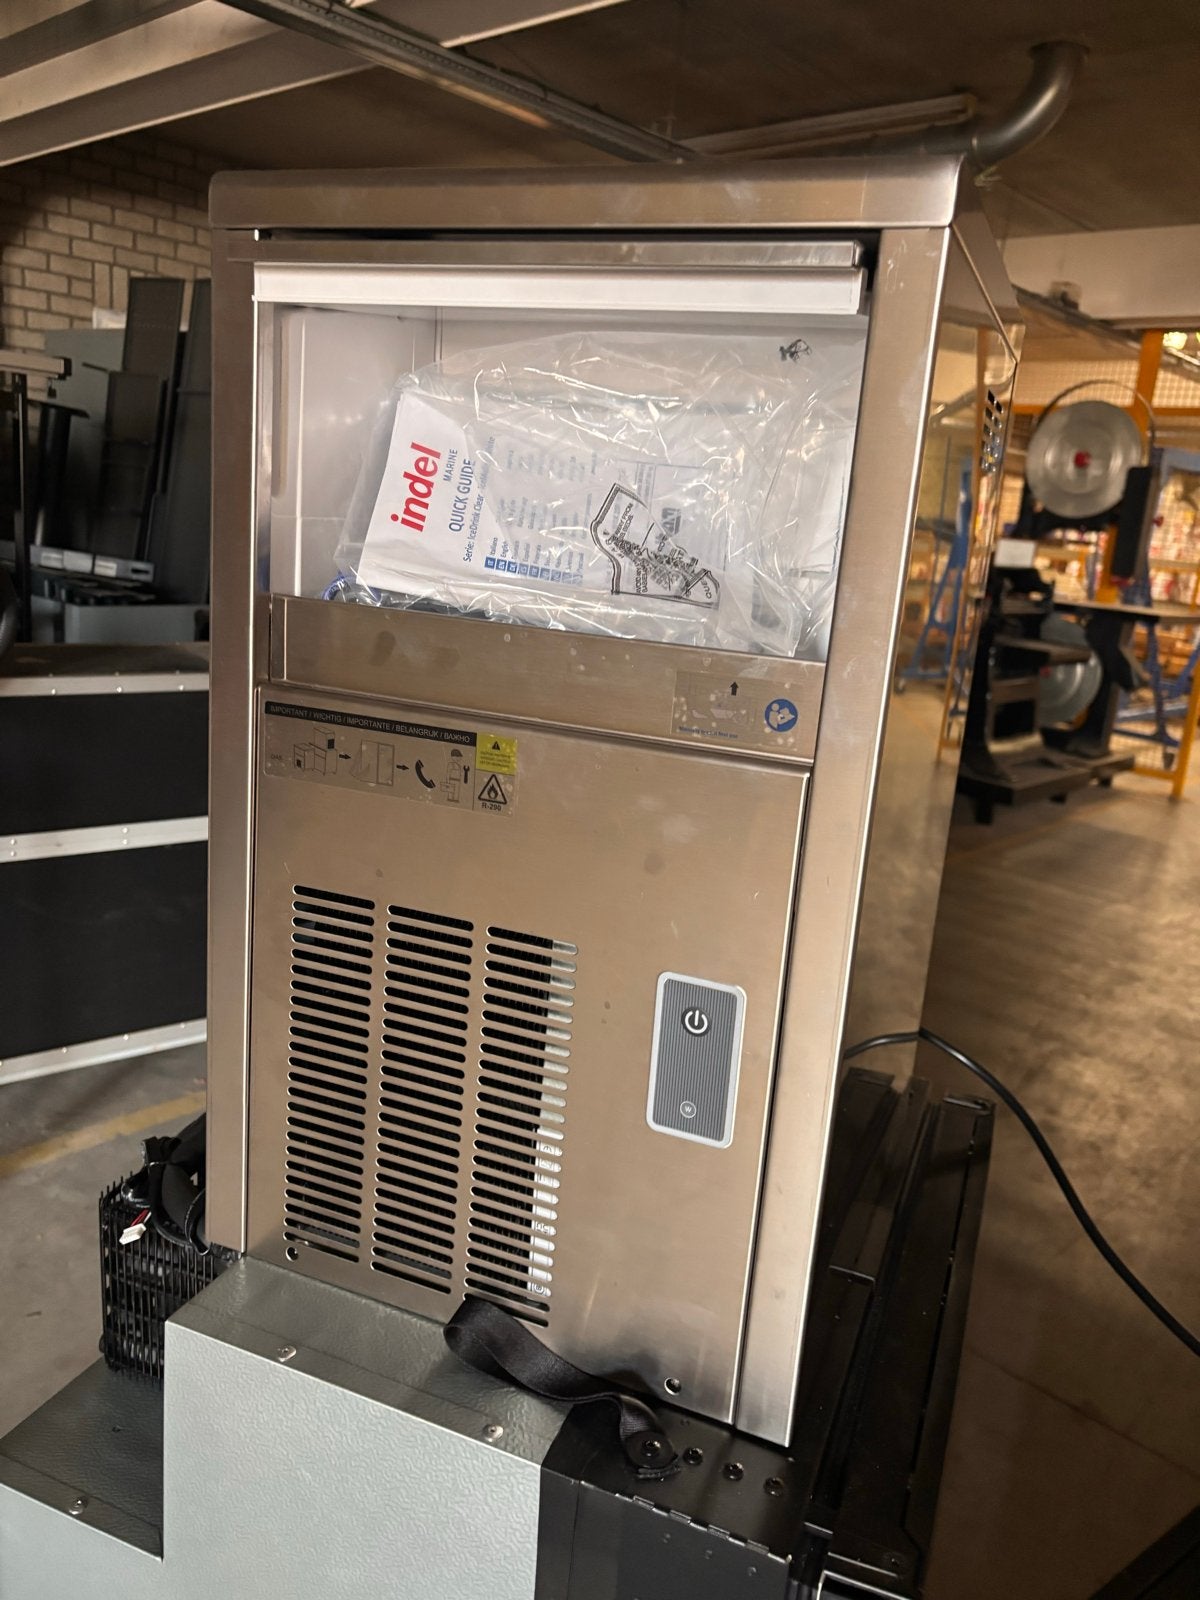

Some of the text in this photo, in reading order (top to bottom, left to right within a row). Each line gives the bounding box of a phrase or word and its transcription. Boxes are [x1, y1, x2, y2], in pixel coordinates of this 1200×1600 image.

[443, 449, 458, 482] MARINE
[391, 442, 441, 532] indel
[449, 459, 475, 532] QUICK GUIDE
[474, 494, 484, 512] Clear
[467, 511, 481, 541] IceDrink
[463, 541, 474, 562] Serie:
[270, 705, 307, 717] IMPORTANT
[313, 712, 341, 723] WICHTIG
[347, 716, 390, 730] IMPORTANTE
[481, 802, 502, 811] R-290
